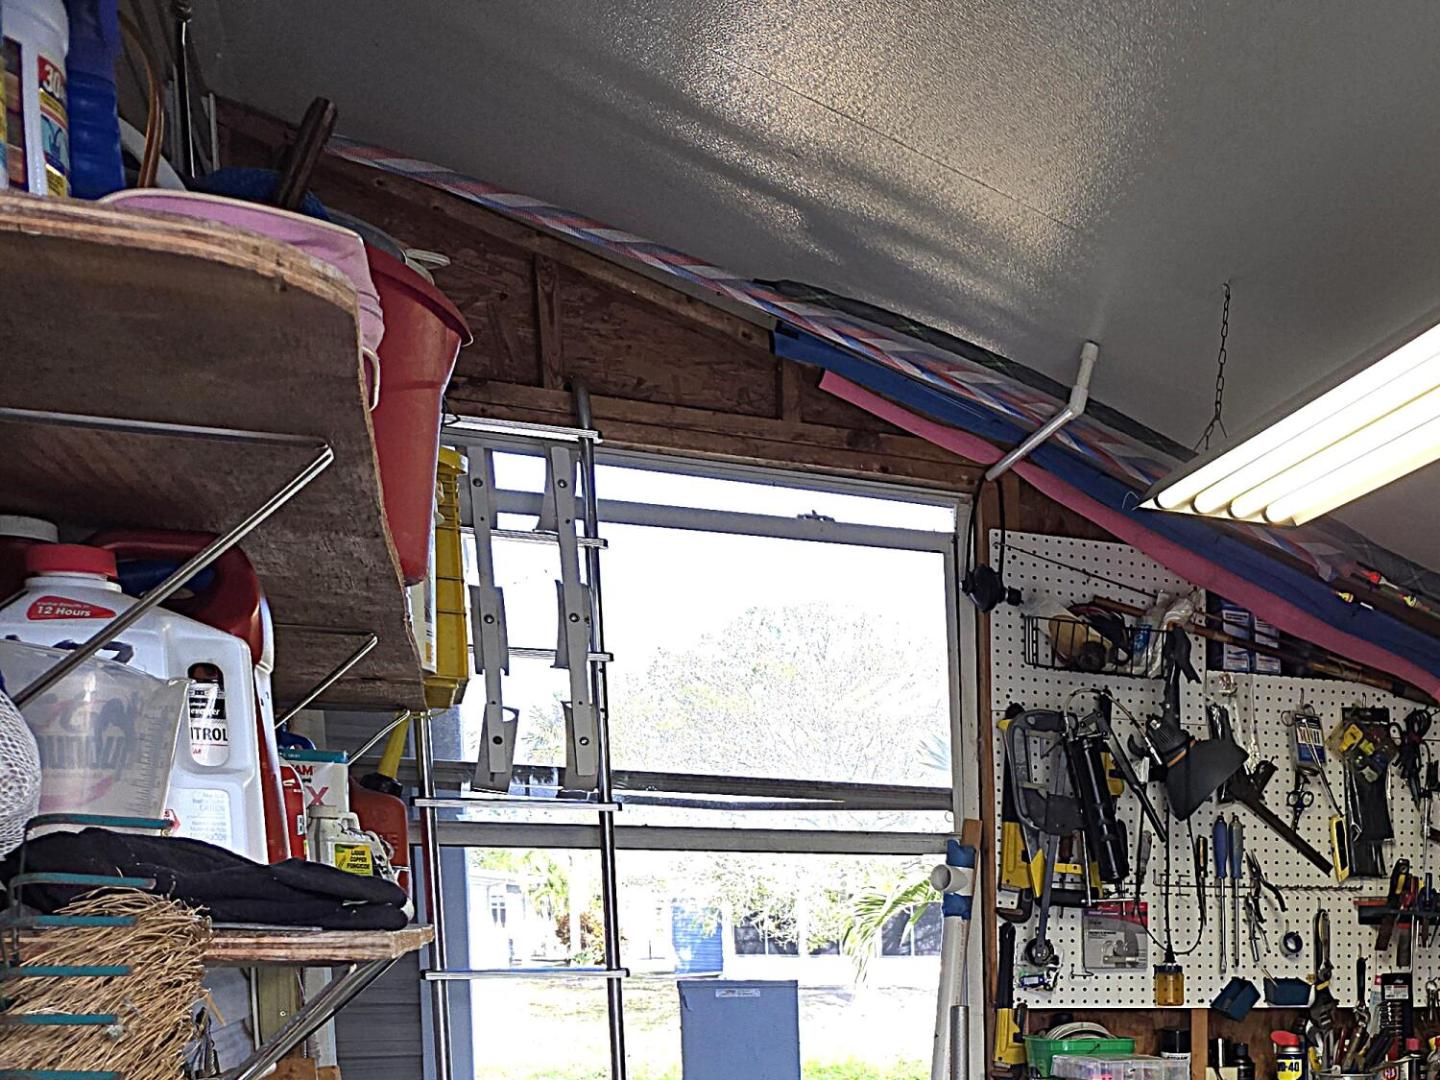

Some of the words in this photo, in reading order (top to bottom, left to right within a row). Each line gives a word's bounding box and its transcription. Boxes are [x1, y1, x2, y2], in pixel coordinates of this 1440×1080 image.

[37, 606, 53, 614] 12
[55, 607, 92, 617] Hours
[191, 727, 228, 741] TROL
